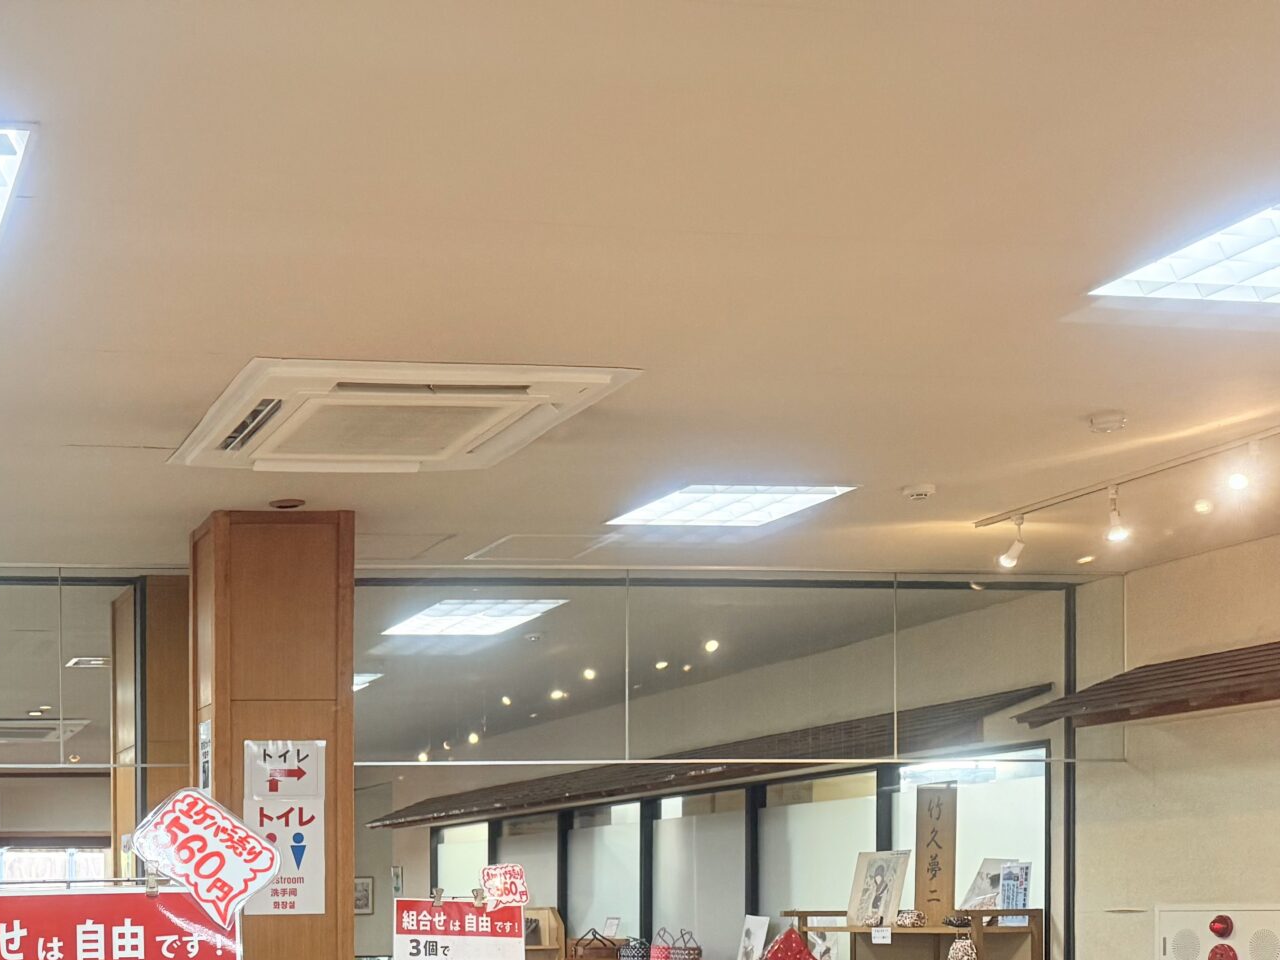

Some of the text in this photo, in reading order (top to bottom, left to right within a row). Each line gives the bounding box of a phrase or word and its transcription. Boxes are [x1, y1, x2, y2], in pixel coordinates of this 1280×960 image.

[262, 748, 309, 763] トイレ
[258, 806, 316, 828] トイレ
[272, 901, 296, 910] 화장실
[408, 938, 451, 957] 3個で
